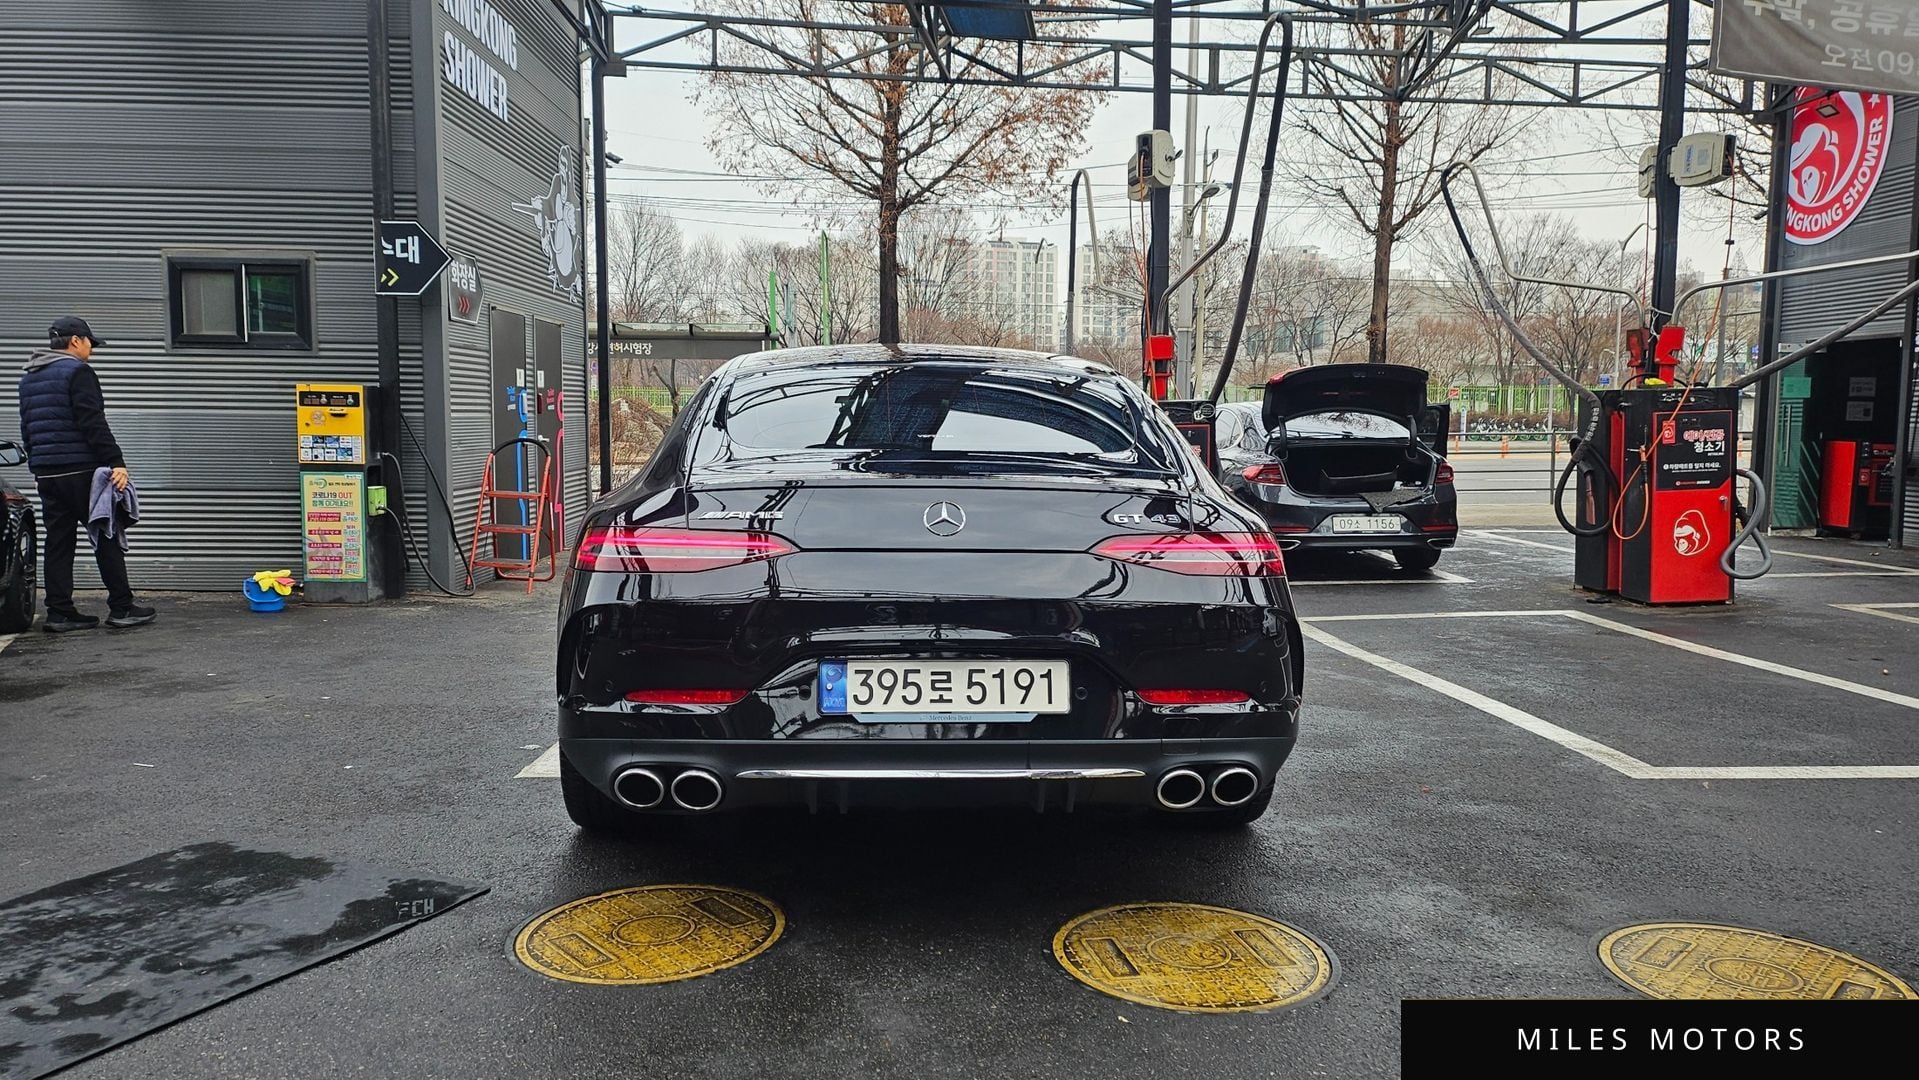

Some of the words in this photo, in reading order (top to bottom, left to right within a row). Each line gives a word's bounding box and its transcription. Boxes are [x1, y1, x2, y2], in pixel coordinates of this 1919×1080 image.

[444, 31, 508, 123] SHOWER
[1787, 203, 1843, 233] NGKONG
[1843, 115, 1884, 211] SHOWER
[450, 260, 477, 293] 화장실
[1694, 441, 1725, 453] 청소기
[724, 511, 784, 520] AMG
[1113, 514, 1143, 524] GT
[1151, 514, 1181, 524] 43
[1367, 519, 1395, 530] 1156
[852, 668, 953, 706] 395로
[966, 668, 1053, 705] 5191
